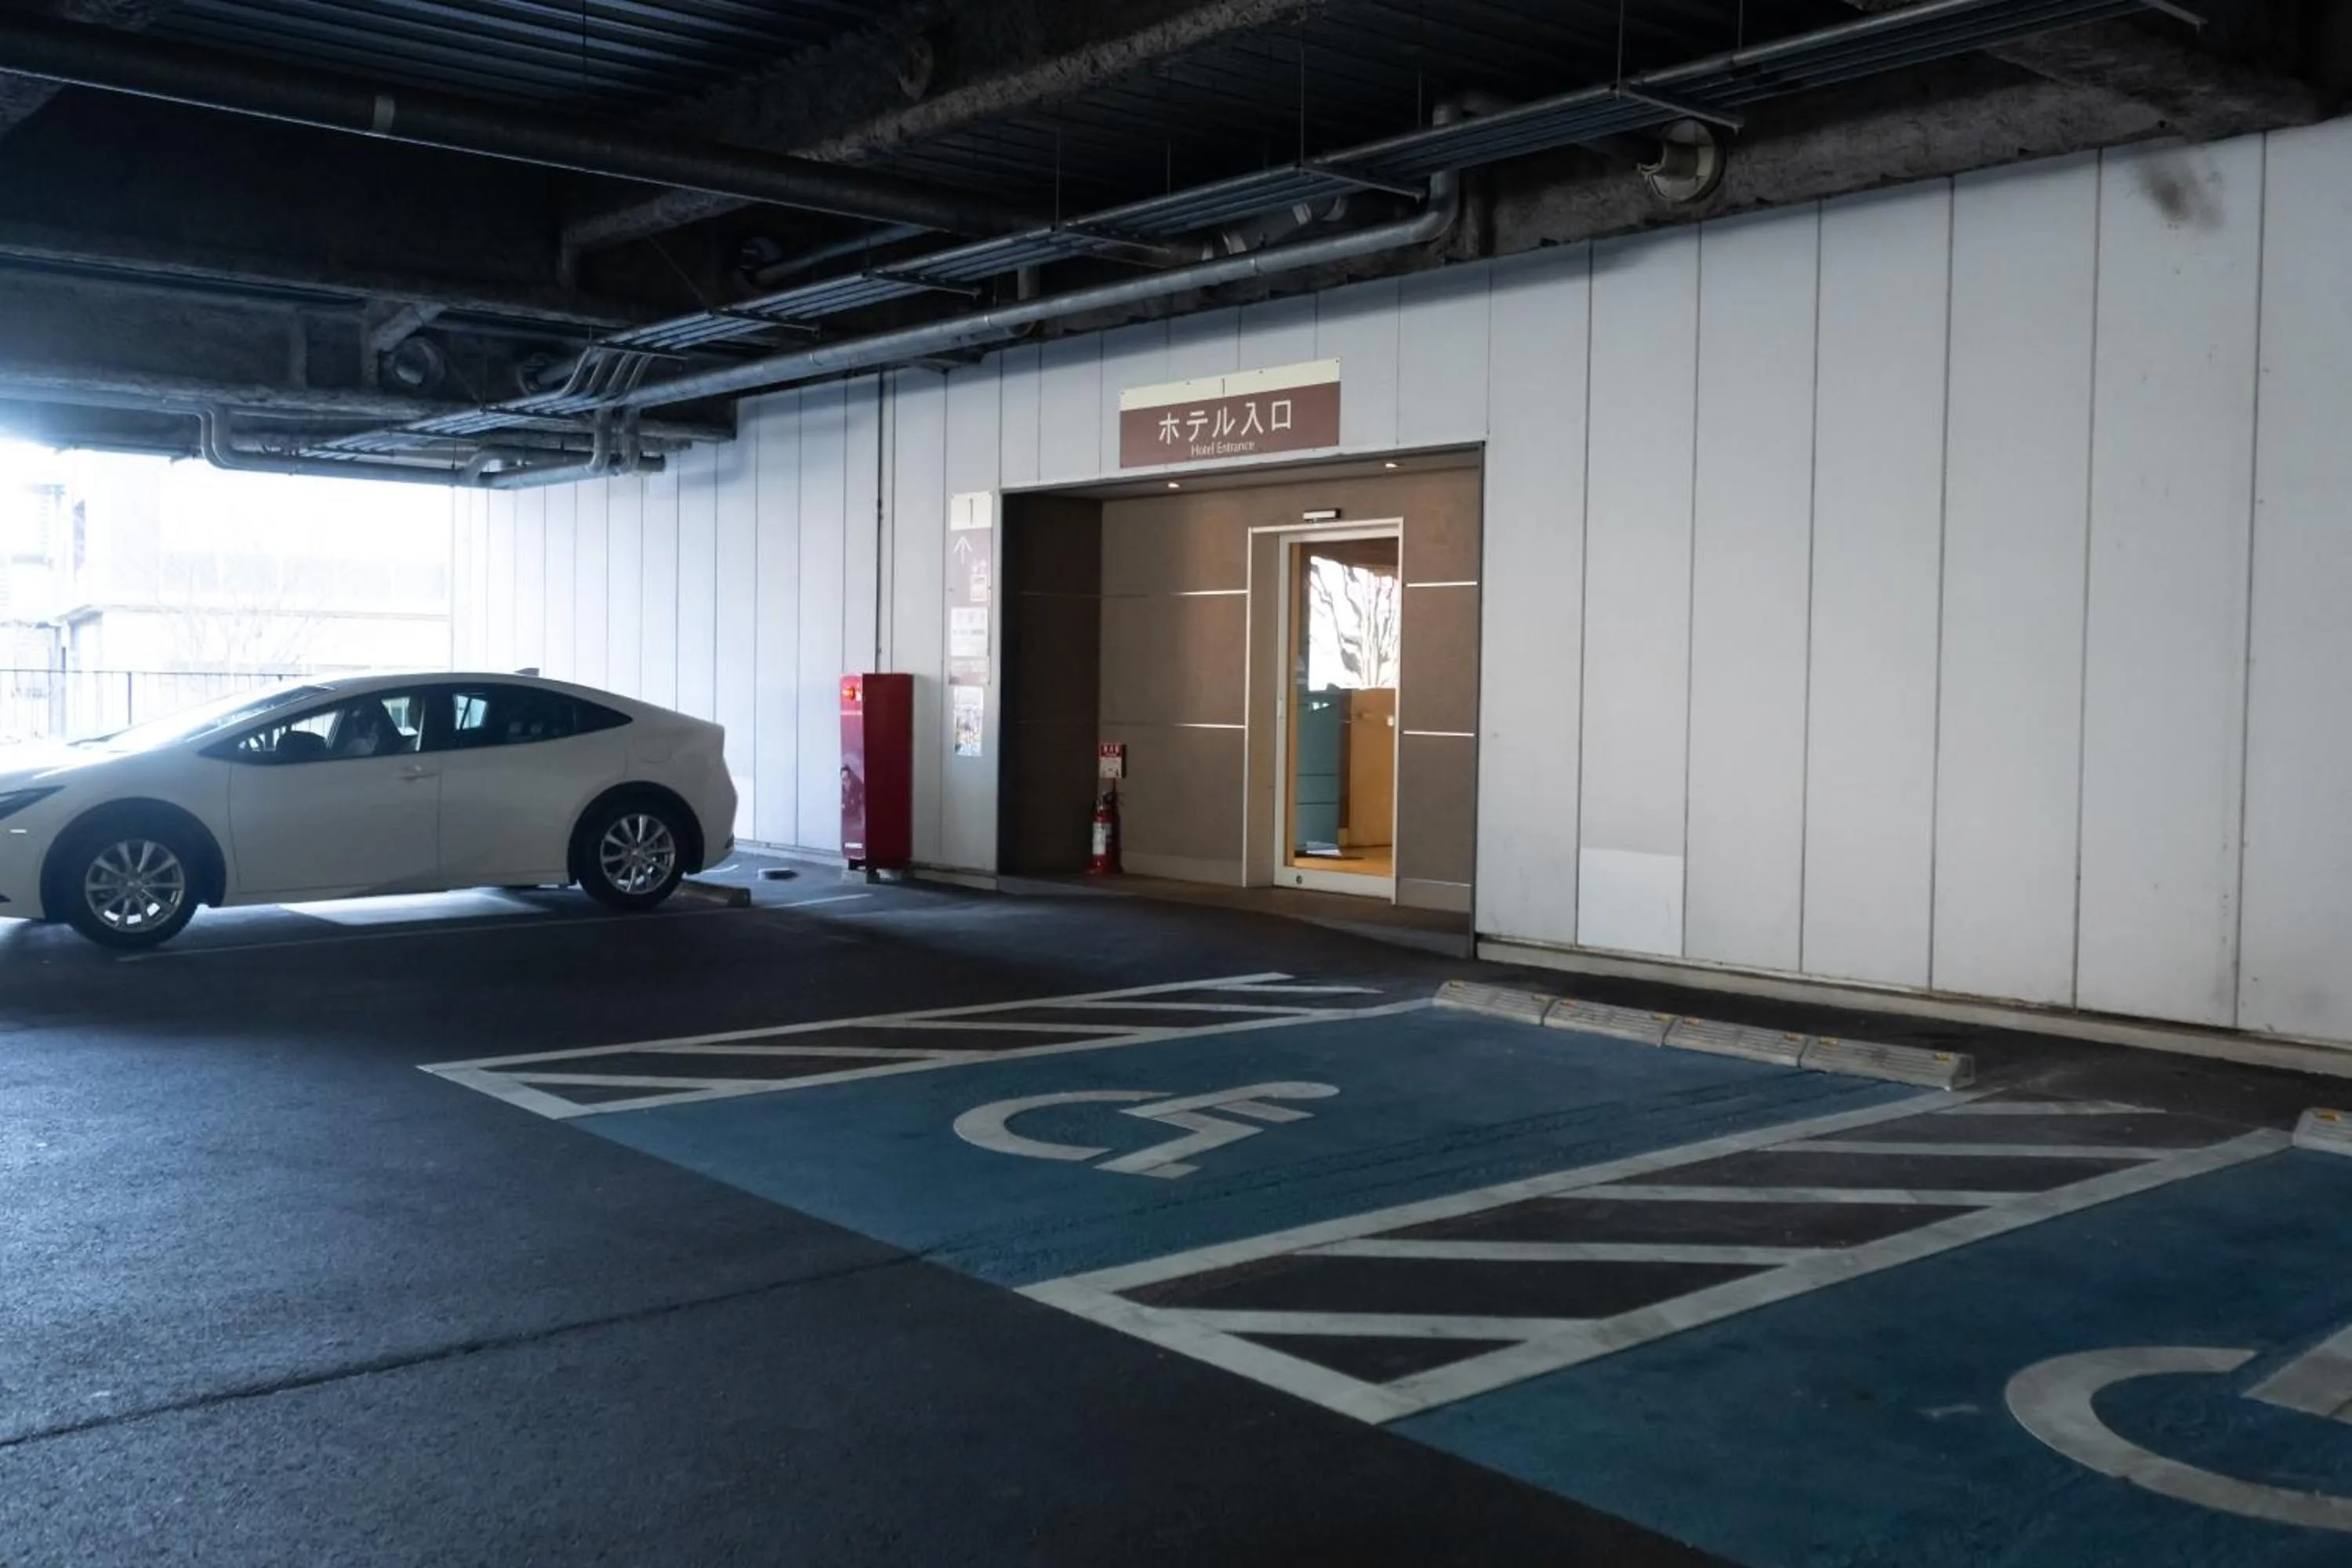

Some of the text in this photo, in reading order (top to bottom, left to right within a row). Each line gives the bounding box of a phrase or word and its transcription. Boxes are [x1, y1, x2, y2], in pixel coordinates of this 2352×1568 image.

[1159, 400, 1292, 445] ホテル入口
[1191, 441, 1255, 456] Hotel Entrance
